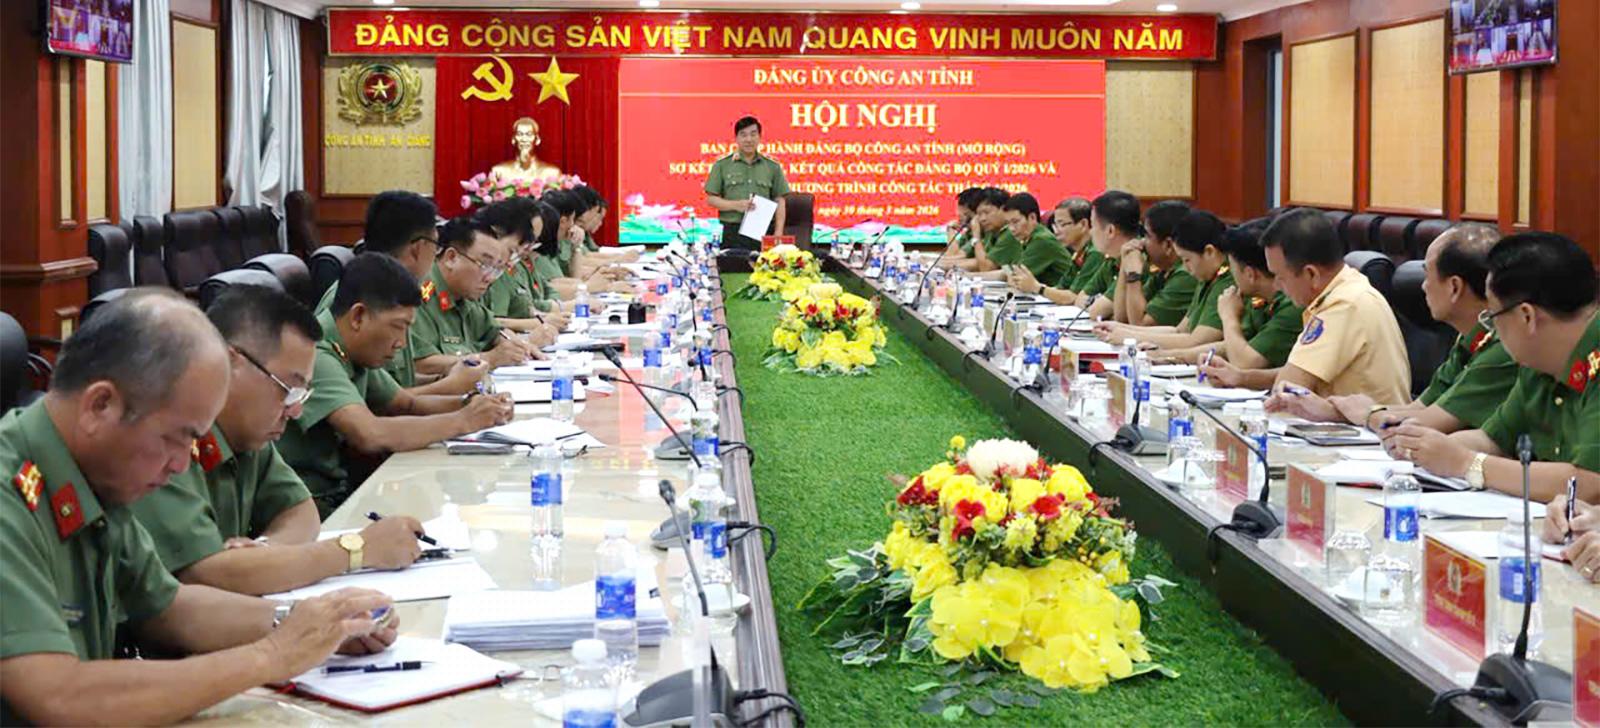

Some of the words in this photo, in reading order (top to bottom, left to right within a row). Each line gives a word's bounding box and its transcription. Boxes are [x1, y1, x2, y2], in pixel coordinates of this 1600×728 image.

[355, 15, 449, 47] ĐẢNG
[461, 17, 555, 52] CỘNG
[566, 15, 631, 48] SẢN
[642, 20, 712, 54] VIỆT
[723, 26, 792, 49] NAM
[805, 26, 917, 50] QUANG
[929, 27, 1000, 50] VINH
[1011, 21, 1101, 50] MUÔN
[1113, 22, 1183, 50] NĂM
[754, 65, 807, 85] ĐẢNG
[811, 65, 838, 85] ỦY
[840, 65, 894, 85] CÔNG
[898, 70, 924, 85] AN
[927, 65, 974, 85] TỈNH
[790, 100, 849, 133] HỘI
[857, 103, 937, 133] NGHỊ
[701, 143, 727, 154] BAN
[729, 143, 765, 154] CP
[766, 141, 803, 154] HÀNH
[805, 141, 842, 154] ĐẢNG
[844, 141, 863, 156] BỘ
[864, 141, 901, 155] CÔNG
[903, 144, 921, 154] AN
[923, 141, 955, 154] TỈNH
[957, 142, 983, 155] (MỞ
[984, 142, 1026, 156] RỘNG)
[669, 162, 688, 174] SƠ
[689, 160, 714, 174] KẾT
[789, 160, 815, 174] KẾT
[817, 160, 845, 176] QUẢ
[847, 160, 884, 174] CÔNG
[887, 160, 913, 174] TÁC
[915, 161, 951, 174] ĐẢNG
[953, 161, 972, 176] BỘ
[974, 161, 1000, 175] QUÝ
[1038, 161, 1056, 174] VÀ
[788, 181, 834, 193] HƯƠNG
[837, 180, 877, 193] TRÌNH
[879, 179, 916, 193] CÔNG
[919, 180, 944, 193] TÁC
[818, 206, 841, 217] ngày
[857, 205, 883, 217] tháng
[894, 206, 915, 215] năm
[916, 205, 940, 215] 2026
